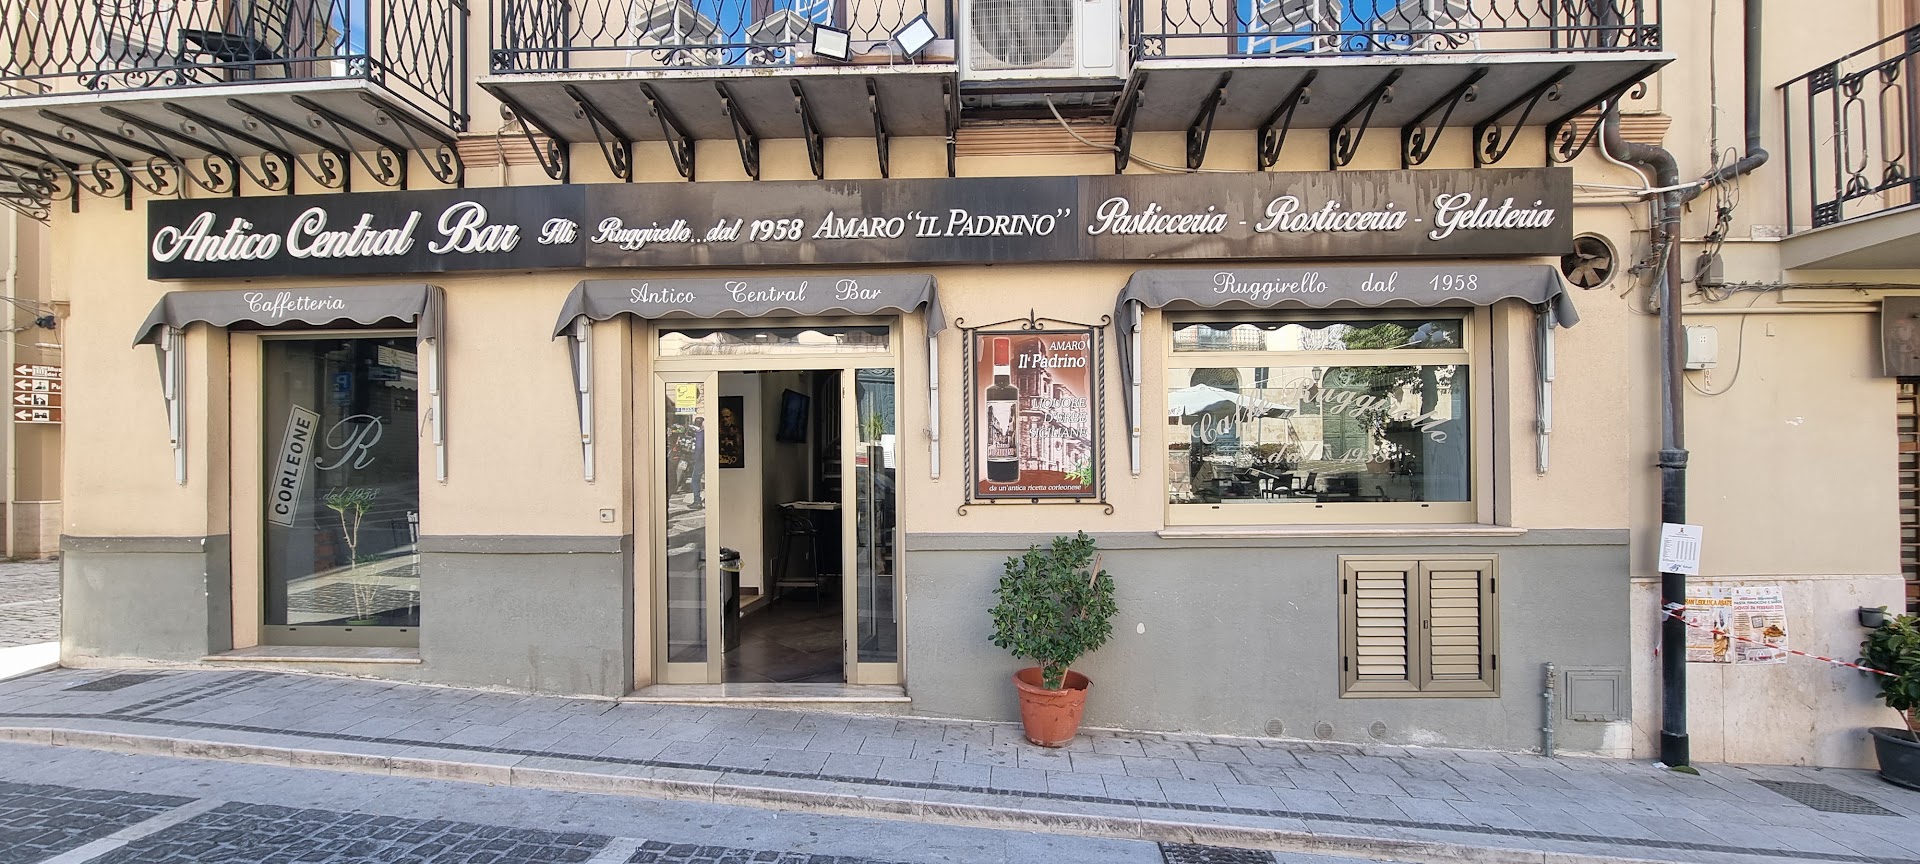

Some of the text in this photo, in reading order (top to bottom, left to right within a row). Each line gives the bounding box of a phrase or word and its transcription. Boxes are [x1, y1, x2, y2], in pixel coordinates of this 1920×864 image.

[152, 211, 281, 262] Antico
[286, 206, 422, 259] Central
[428, 201, 521, 254] Bar
[750, 218, 805, 242] 1958
[812, 210, 906, 239] AMARO
[1087, 196, 1228, 235] Pasticceria
[1254, 195, 1407, 234] Rosticceria
[1428, 192, 1555, 241] Gelateria
[630, 278, 882, 304] Antico Central Bar
[1213, 271, 1478, 301] Ruggirello dal 1958
[243, 291, 346, 318] Caffetteria
[1049, 340, 1086, 351] AMARO
[1032, 353, 1086, 369] Padrino
[314, 414, 383, 471] R
[1029, 427, 1088, 438] SICILIANE
[275, 416, 311, 515] CORLEONE
[1339, 447, 1390, 464] 1958
